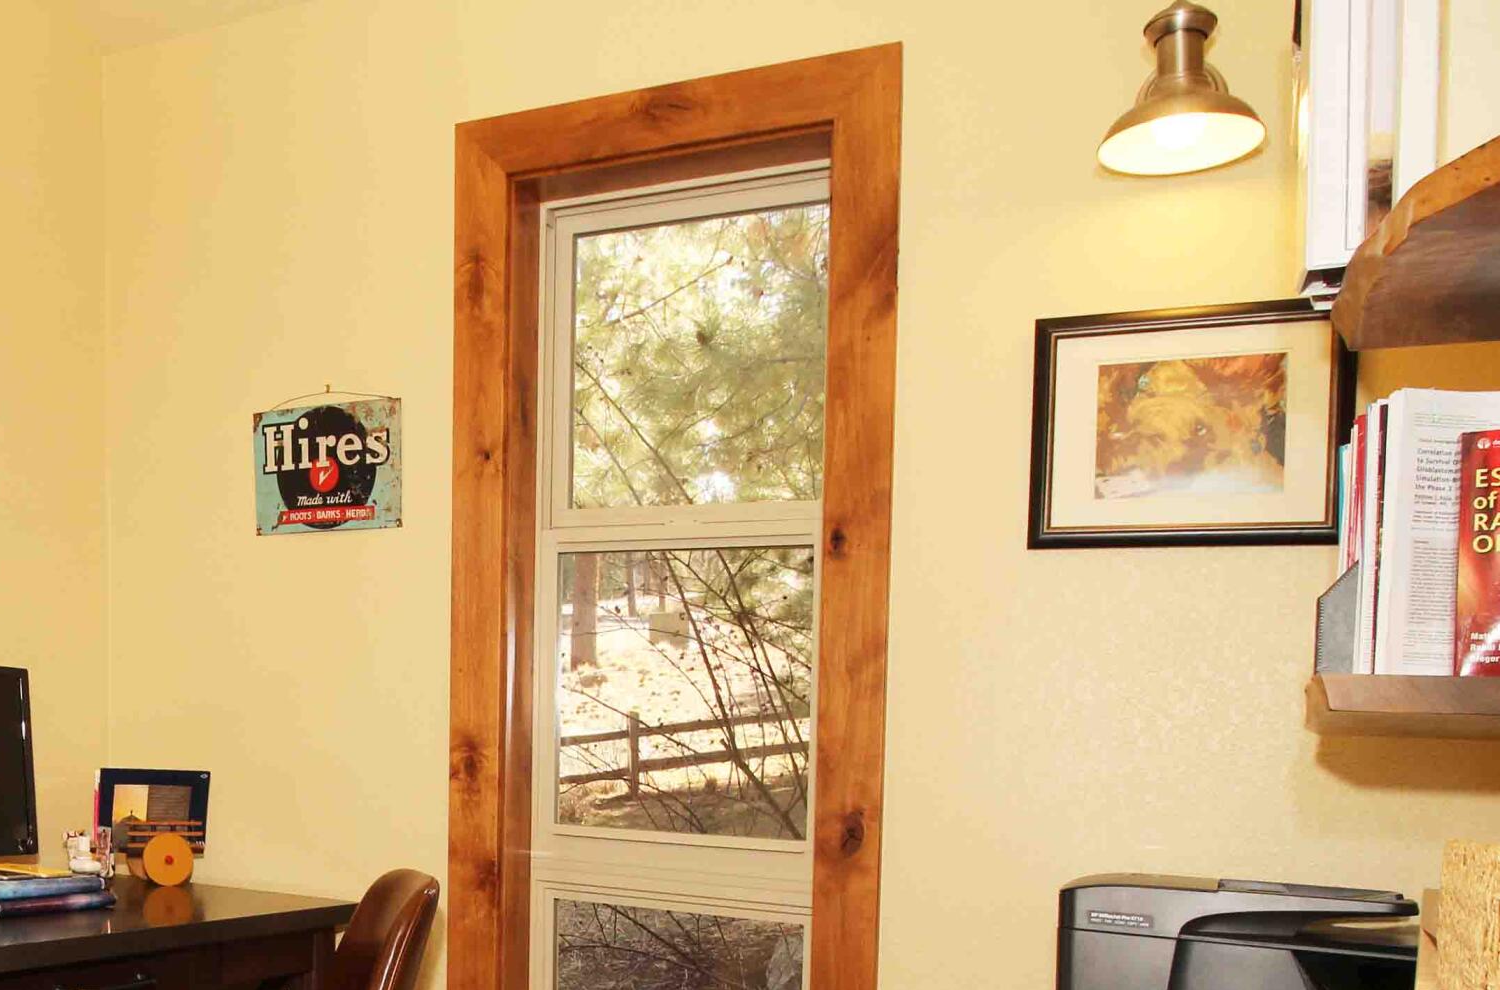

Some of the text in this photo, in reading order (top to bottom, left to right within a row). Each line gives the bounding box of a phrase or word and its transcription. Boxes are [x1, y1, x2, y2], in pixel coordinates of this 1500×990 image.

[263, 416, 390, 474] Hires
[297, 490, 353, 506] Made with
[1473, 491, 1498, 510] of
[290, 512, 312, 521] ROOTS
[316, 510, 341, 520] BARKS
